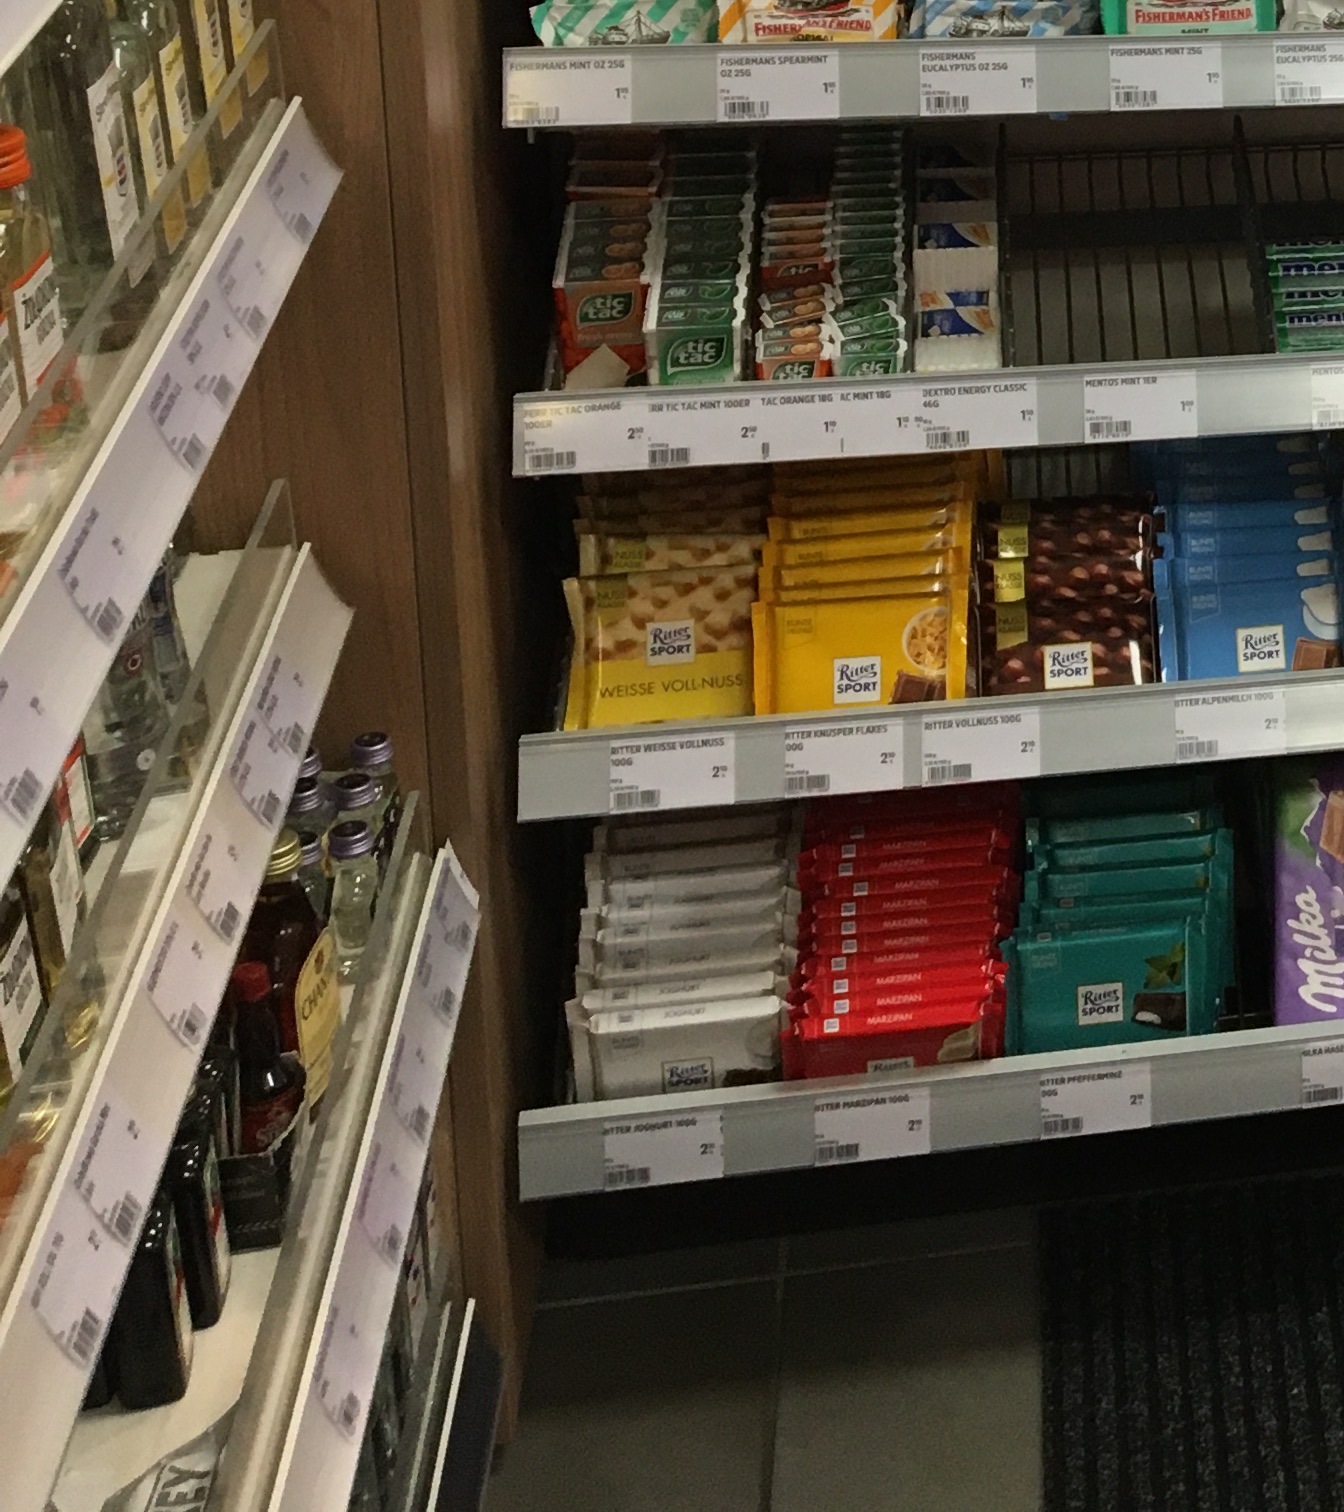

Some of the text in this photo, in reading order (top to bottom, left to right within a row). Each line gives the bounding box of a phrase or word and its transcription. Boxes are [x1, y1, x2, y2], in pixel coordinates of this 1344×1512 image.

[509, 60, 567, 72] FISHERMANS
[570, 60, 592, 71] MINT
[720, 55, 827, 68] FISHERMANS SPEARMINT
[922, 63, 974, 72] EUCALYPTUS
[686, 340, 717, 355] tic
[680, 352, 718, 365] tac
[649, 626, 691, 645] Ritter
[650, 642, 691, 656] SPORT
[599, 681, 655, 700] WEISSE
[924, 719, 954, 730] RITTER
[957, 716, 999, 727] VOLLNUSS
[611, 739, 725, 755] RITTER WEISSE VOLLNUSS
